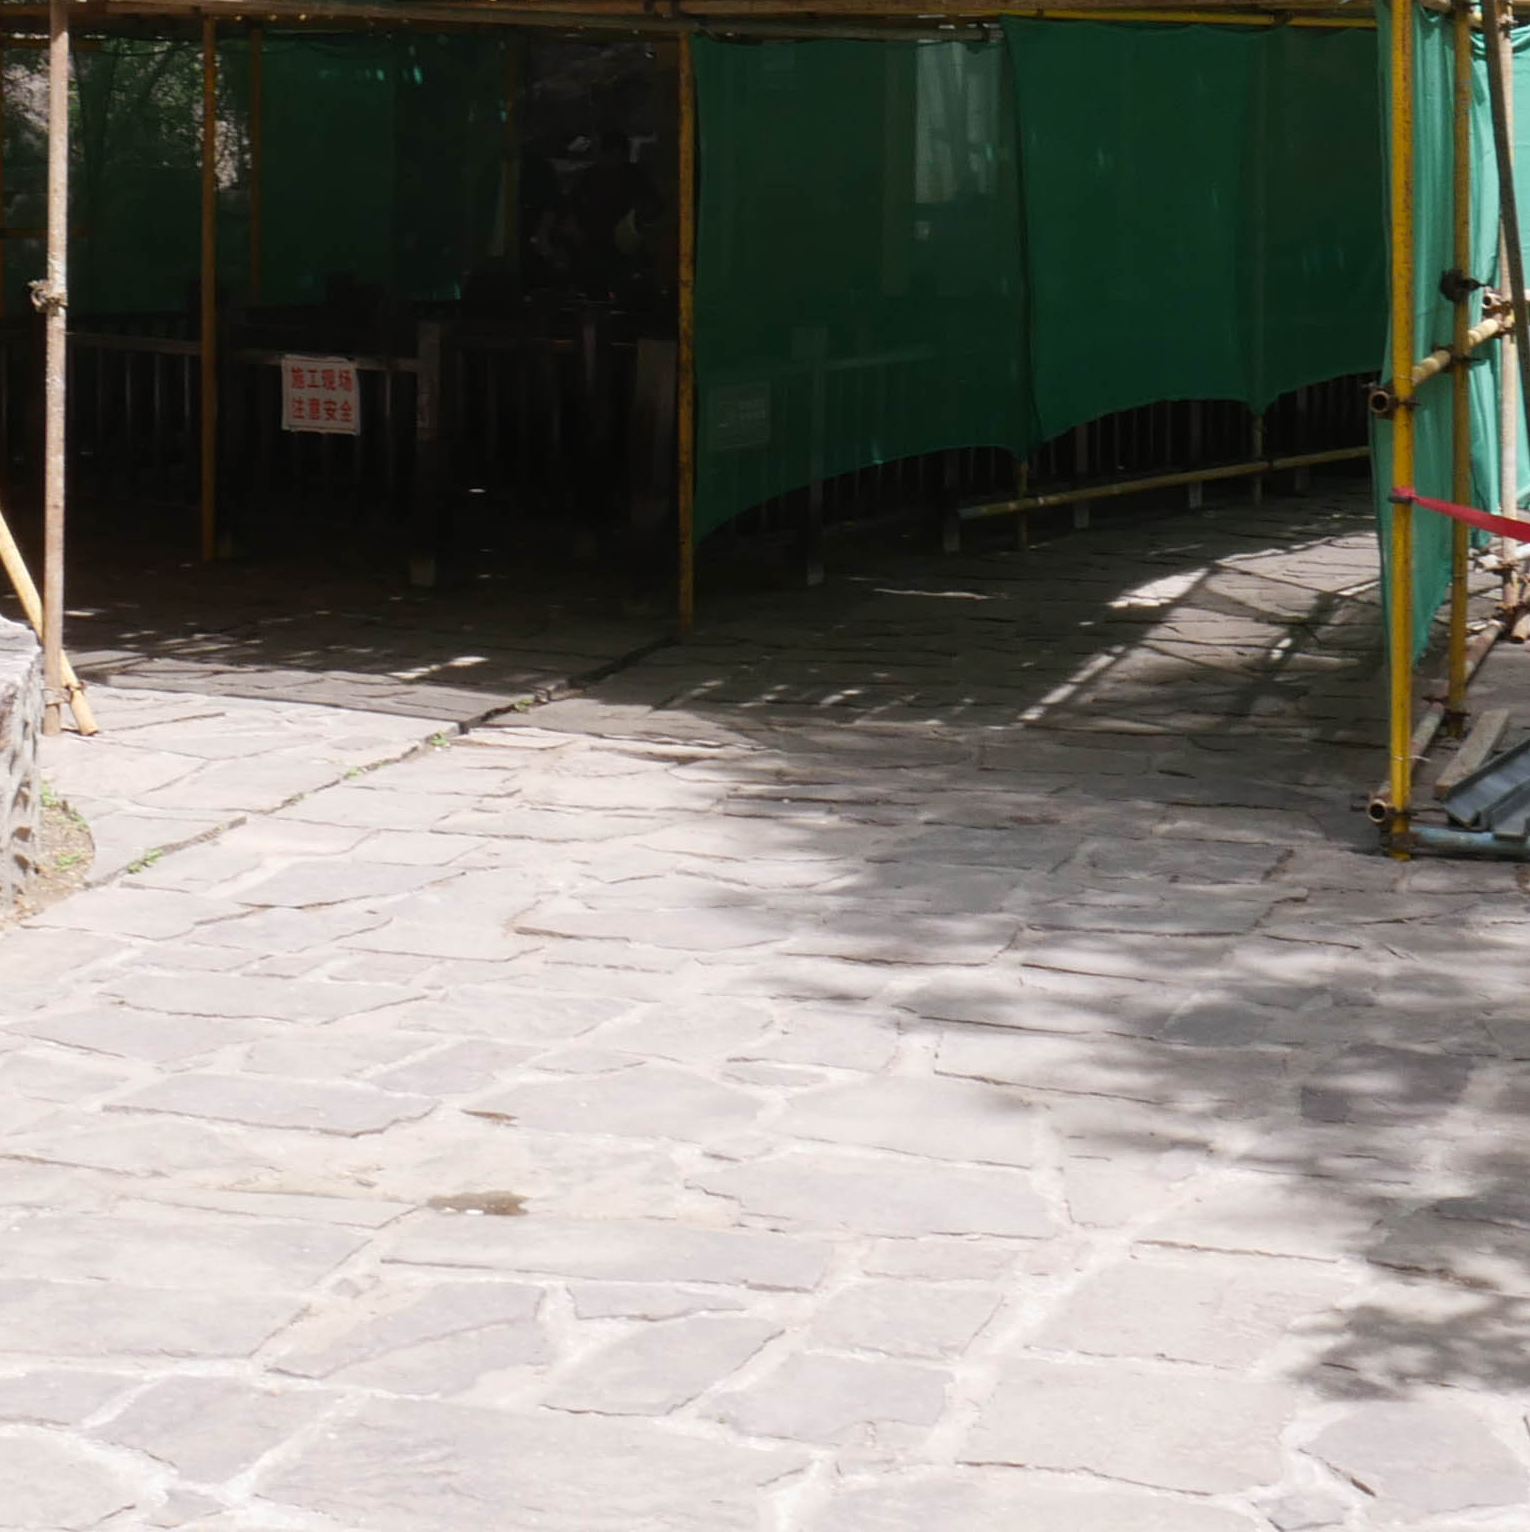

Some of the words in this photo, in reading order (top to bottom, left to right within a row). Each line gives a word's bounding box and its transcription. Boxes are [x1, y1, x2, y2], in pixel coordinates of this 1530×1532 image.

[291, 366, 353, 392] 施工现场
[291, 396, 353, 422] 注意安全
